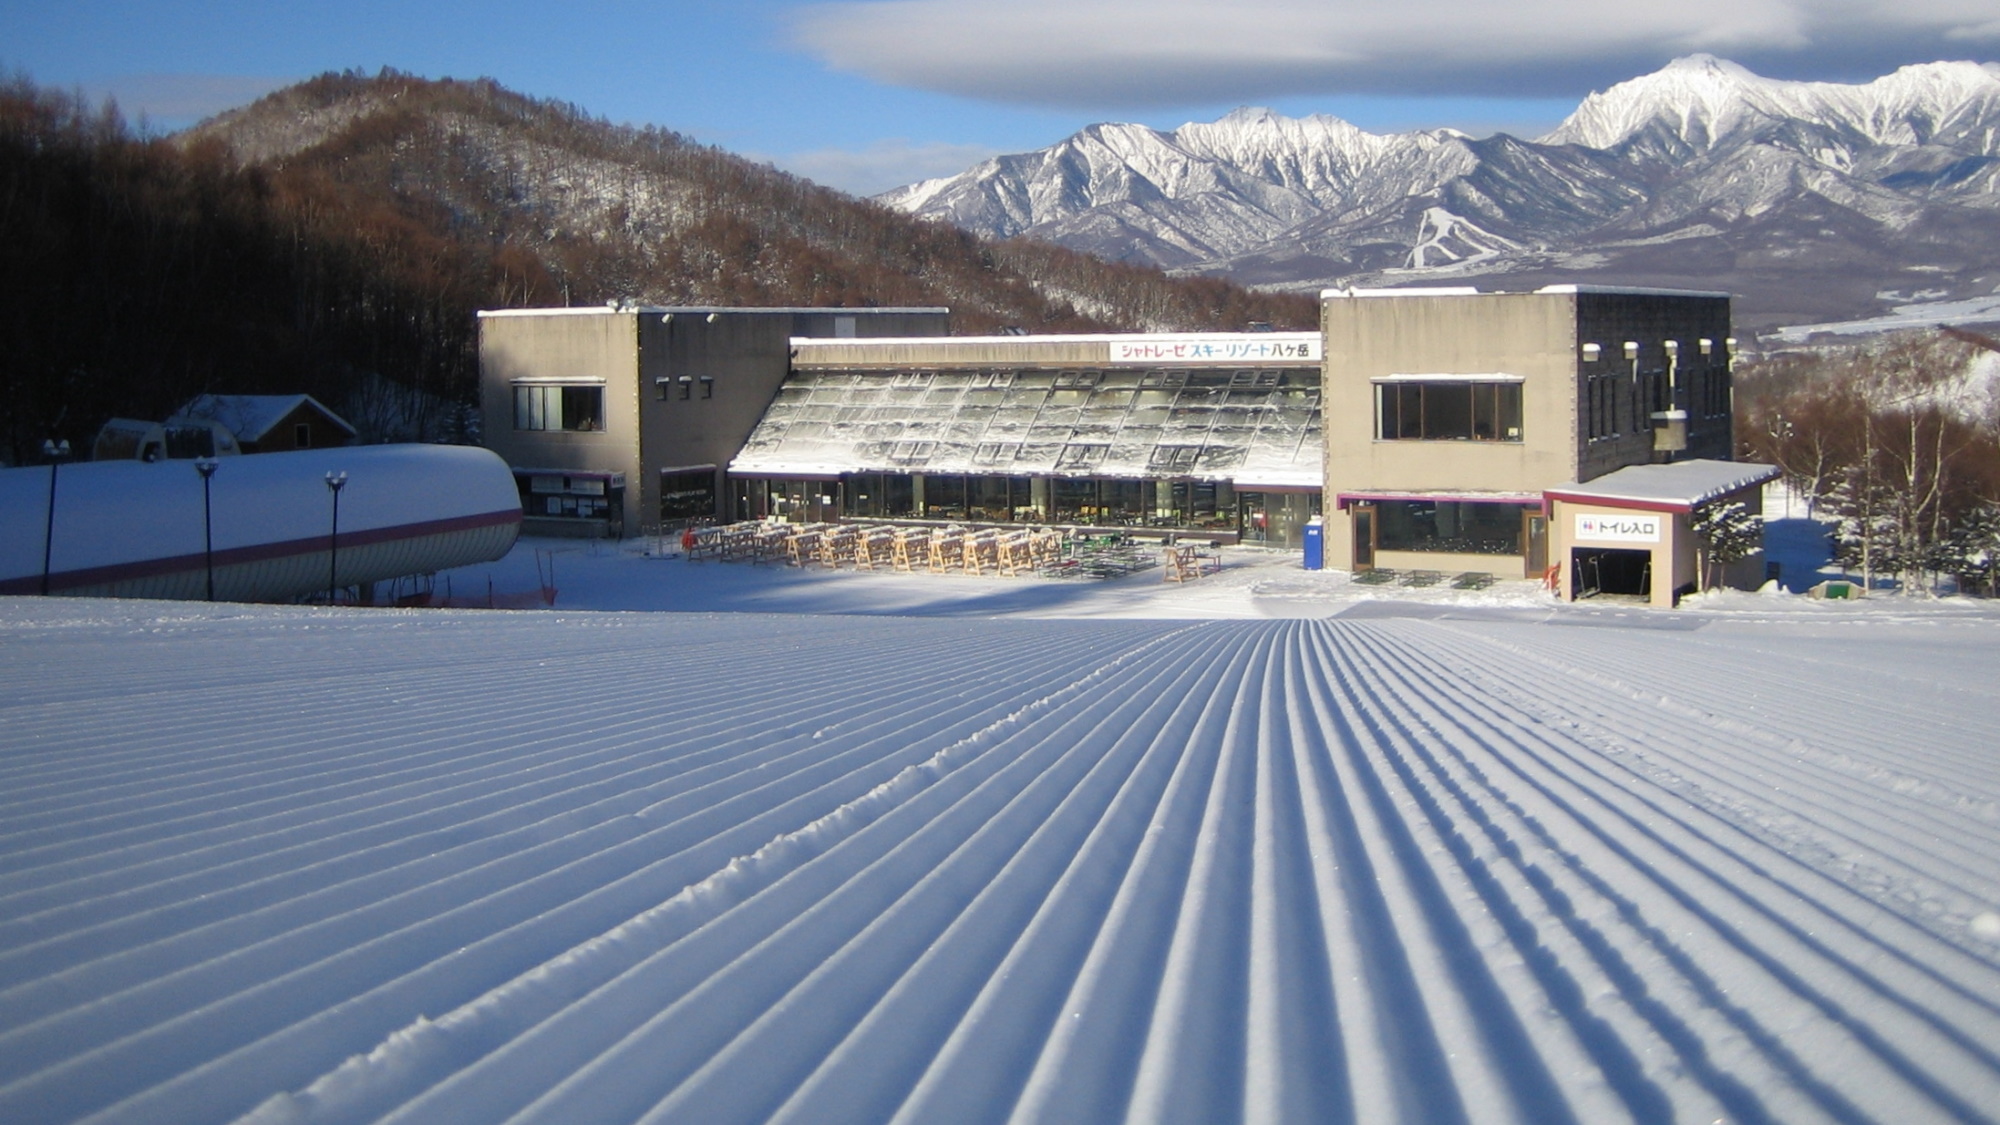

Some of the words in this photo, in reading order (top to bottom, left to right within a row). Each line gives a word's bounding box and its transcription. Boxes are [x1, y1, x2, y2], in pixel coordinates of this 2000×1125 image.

[1122, 344, 1186, 358] シャトレーゼ
[1600, 521, 1654, 534] トイレ入口
